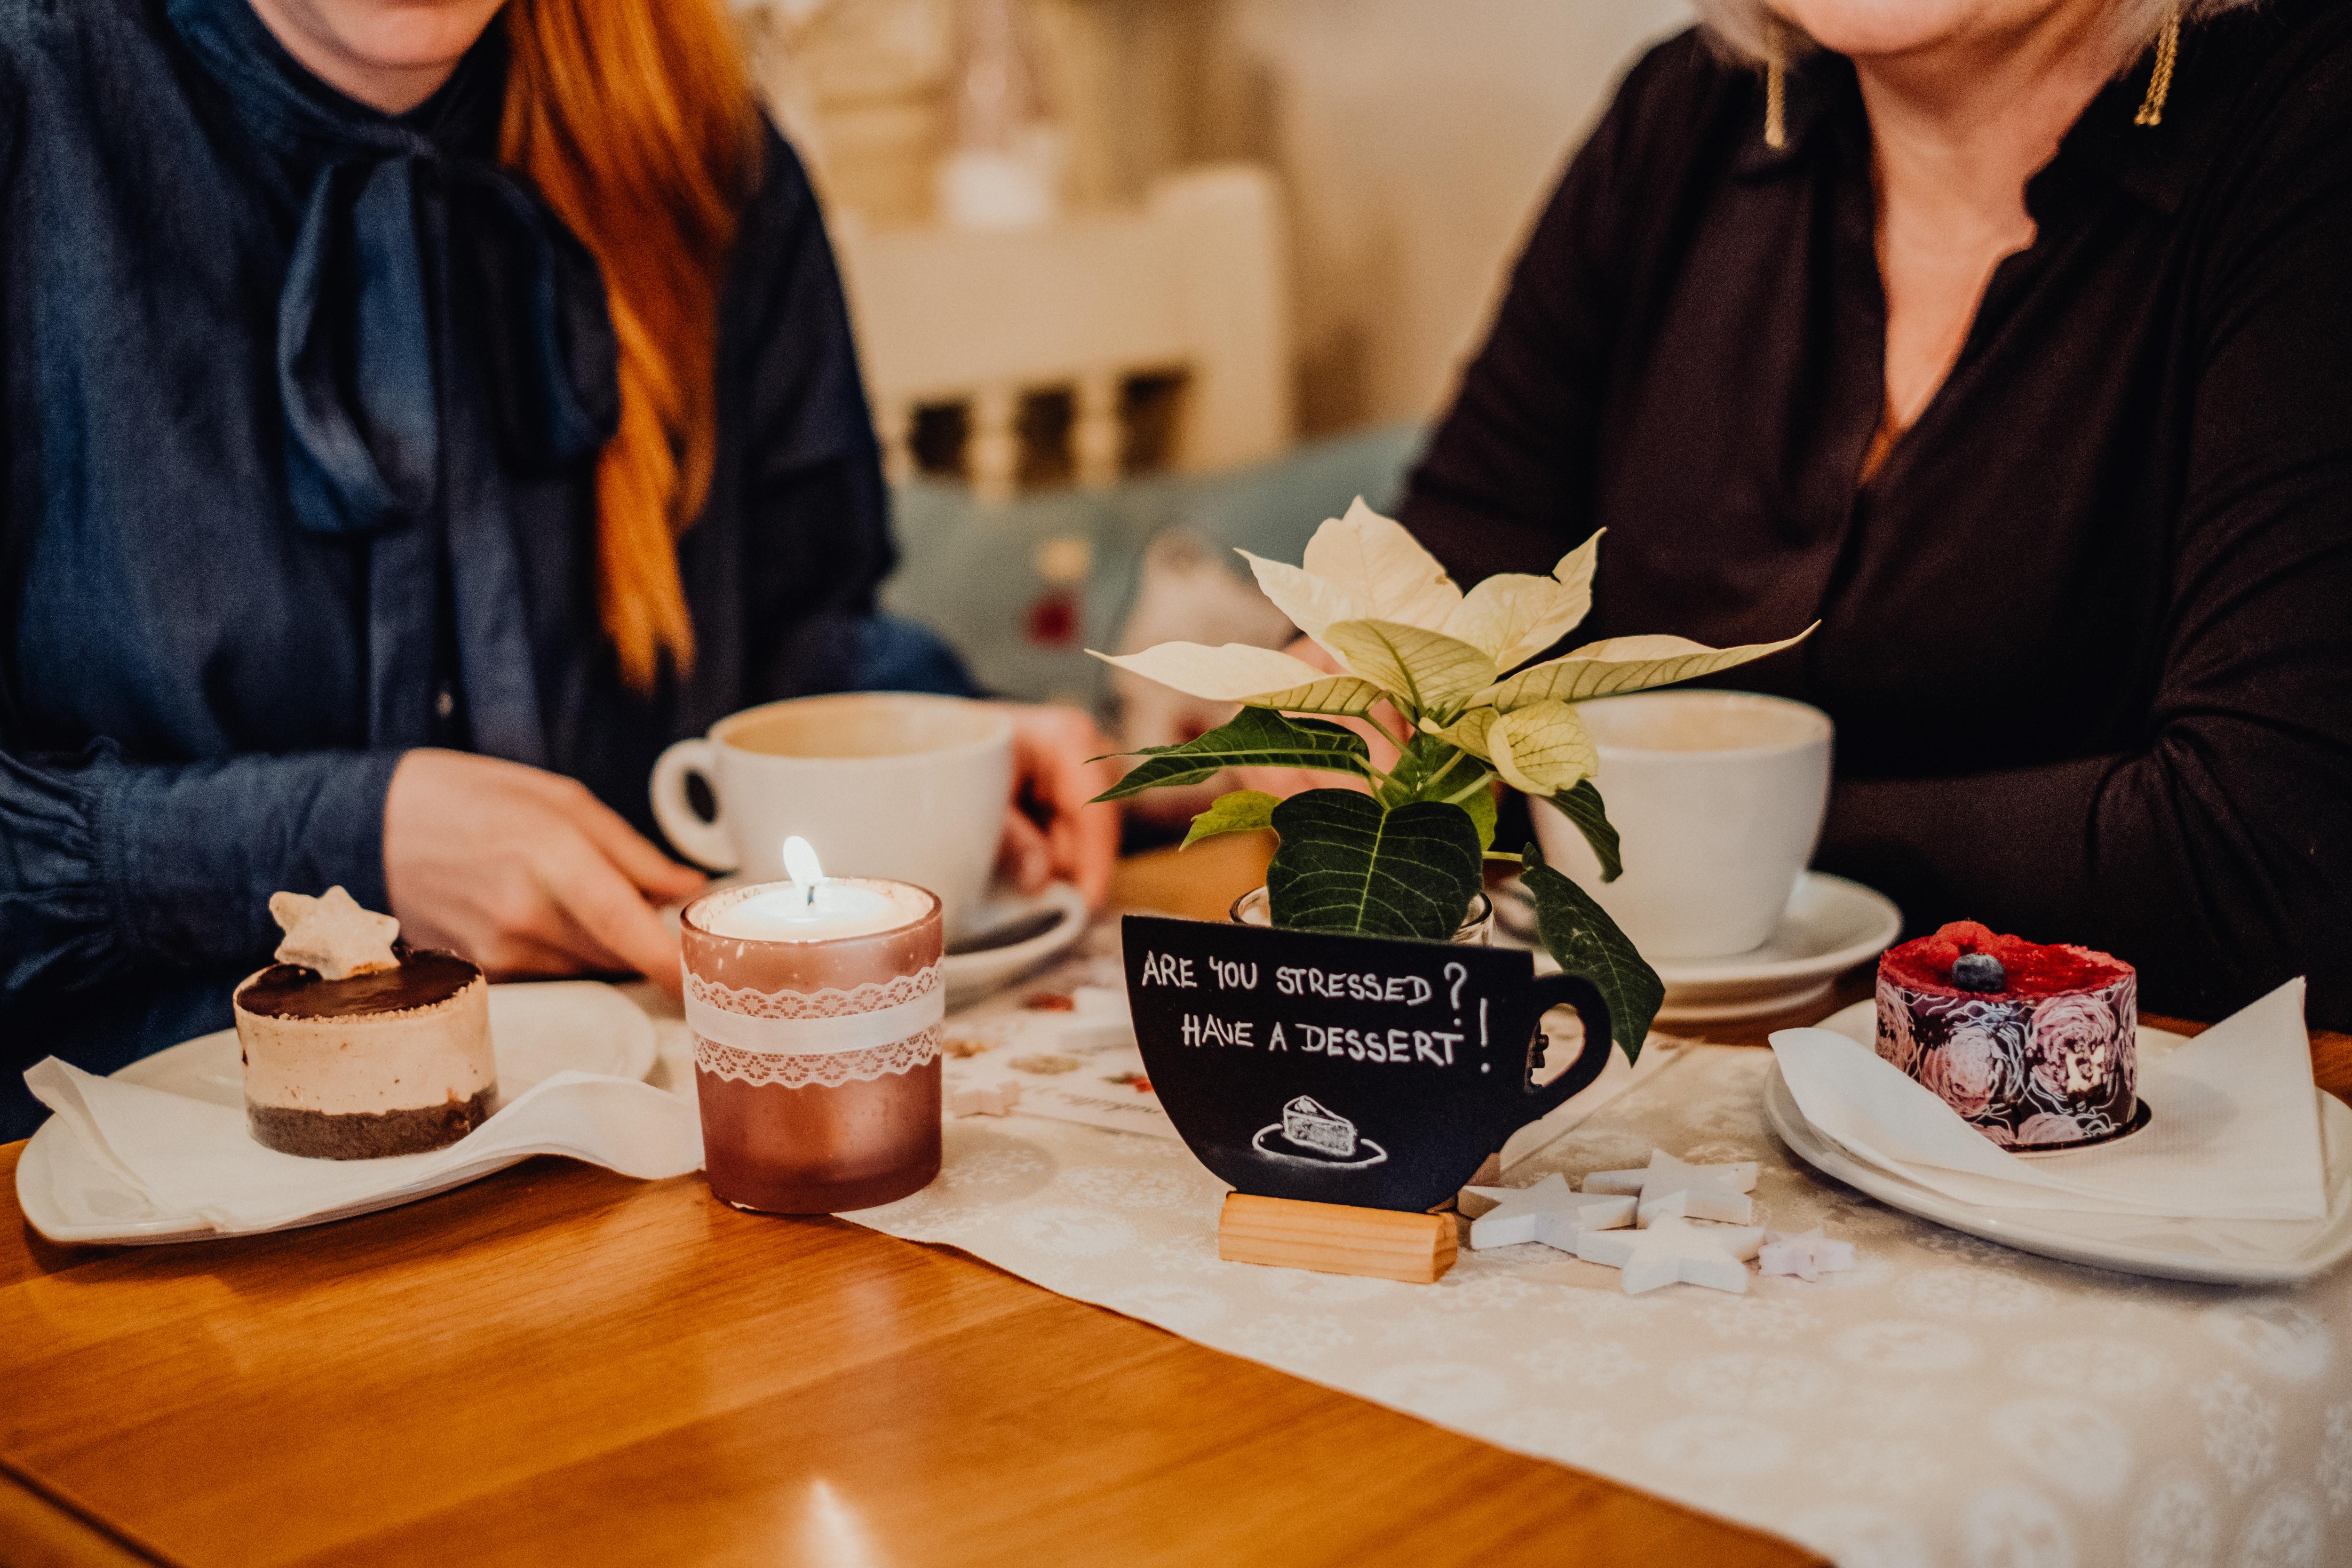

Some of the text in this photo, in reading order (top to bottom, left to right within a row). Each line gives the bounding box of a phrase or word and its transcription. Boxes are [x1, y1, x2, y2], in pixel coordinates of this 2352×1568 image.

[1142, 950, 1198, 987] ARE
[1209, 955, 1257, 989] YOU
[1182, 1013, 1254, 1048] HAVE
[1269, 1022, 1287, 1051] A
